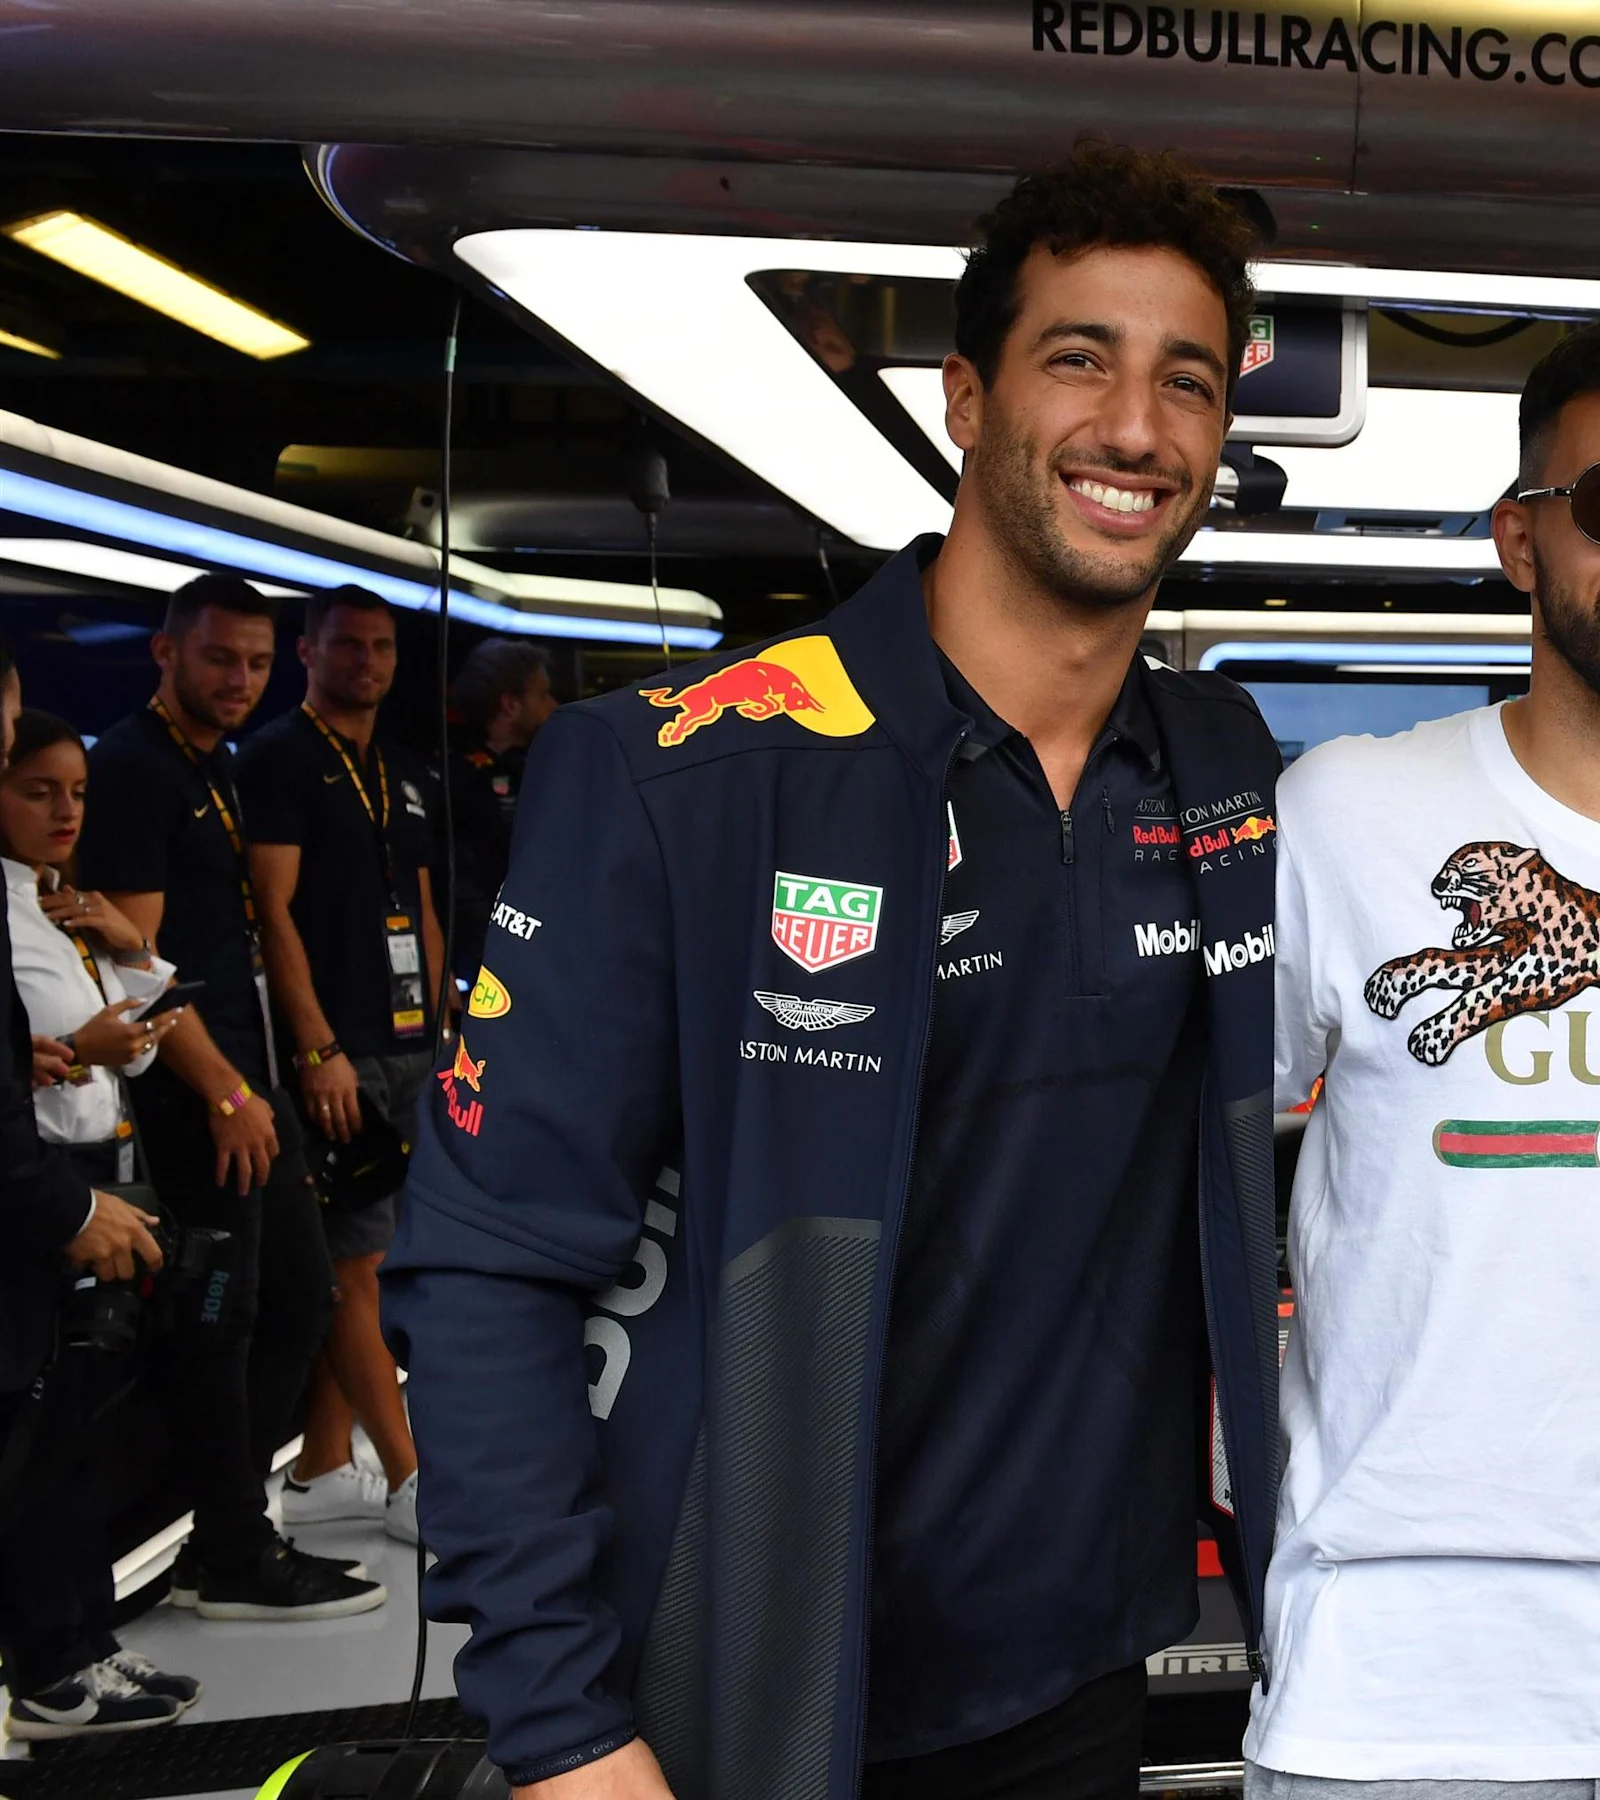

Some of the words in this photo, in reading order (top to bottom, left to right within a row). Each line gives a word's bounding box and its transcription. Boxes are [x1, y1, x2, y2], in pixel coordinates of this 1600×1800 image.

[1211, 790, 1262, 817] MARTIN
[1132, 825, 1157, 844] Red
[1204, 828, 1231, 854] Bull
[780, 880, 870, 918] TAG
[492, 901, 543, 941] AT&T
[774, 911, 869, 966] HEUER
[1134, 920, 1200, 957] Mobil
[1203, 924, 1275, 977] Mobil
[781, 1001, 802, 1010] ASTON
[804, 1004, 833, 1015] MARTIN
[794, 1046, 882, 1073] MARTIN
